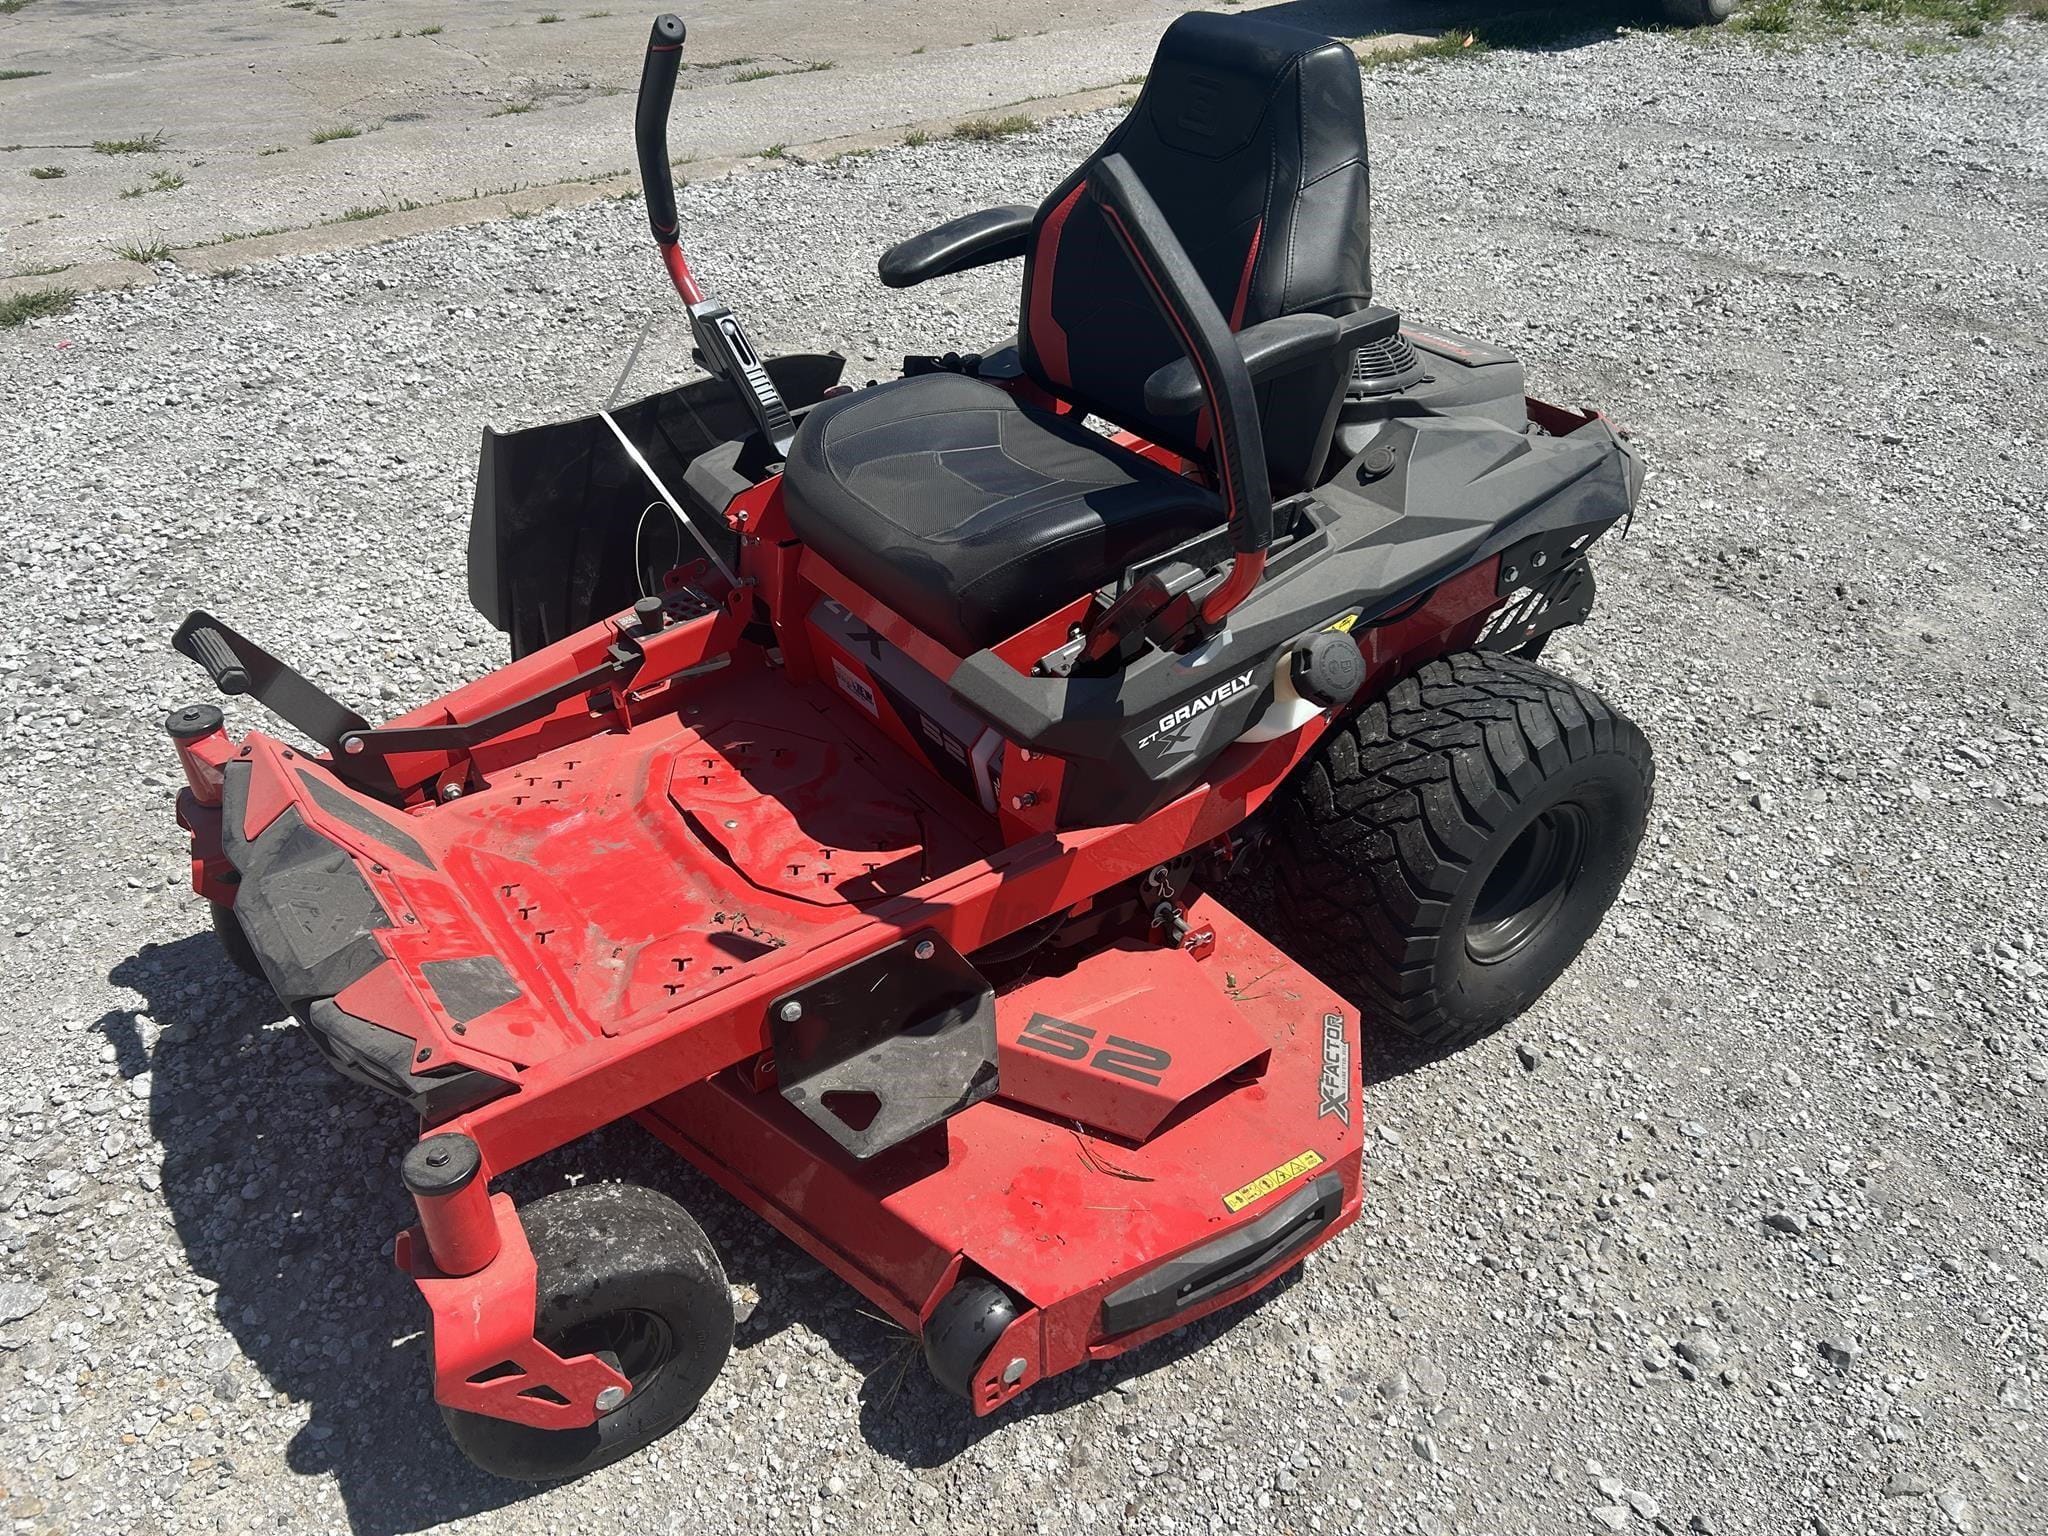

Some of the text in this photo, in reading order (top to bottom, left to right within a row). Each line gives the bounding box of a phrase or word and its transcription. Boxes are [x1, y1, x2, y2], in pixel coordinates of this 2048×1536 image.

[1158, 669, 1254, 733] GRAVELY
[920, 713, 968, 768] 52
[1138, 720, 1194, 760] ZT X
[1016, 1012, 1172, 1087] 52
[1320, 1013, 1348, 1122] X-FACTOR
